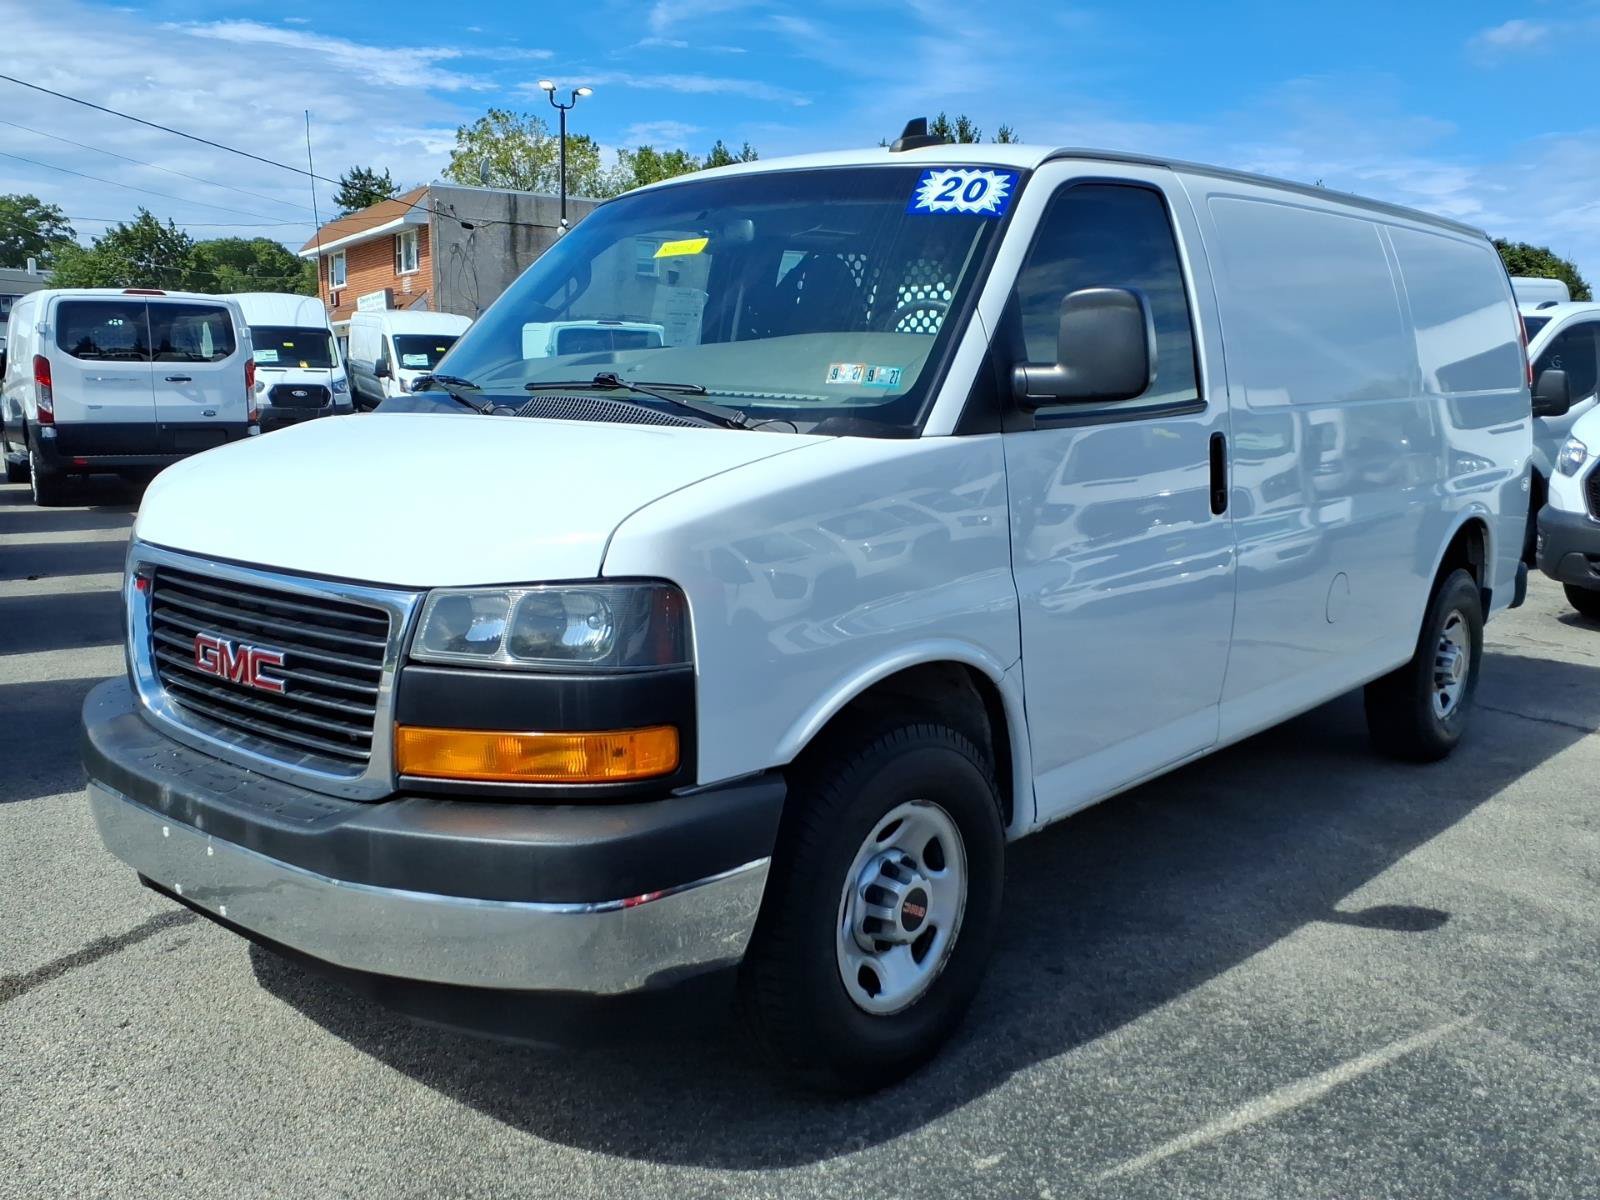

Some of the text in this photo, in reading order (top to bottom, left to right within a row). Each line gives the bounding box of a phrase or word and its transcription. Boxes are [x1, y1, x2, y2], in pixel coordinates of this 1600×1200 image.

[933, 176, 988, 203] 20
[831, 367, 839, 381] 9
[867, 369, 900, 385] 9 27
[194, 632, 286, 694] GMC
